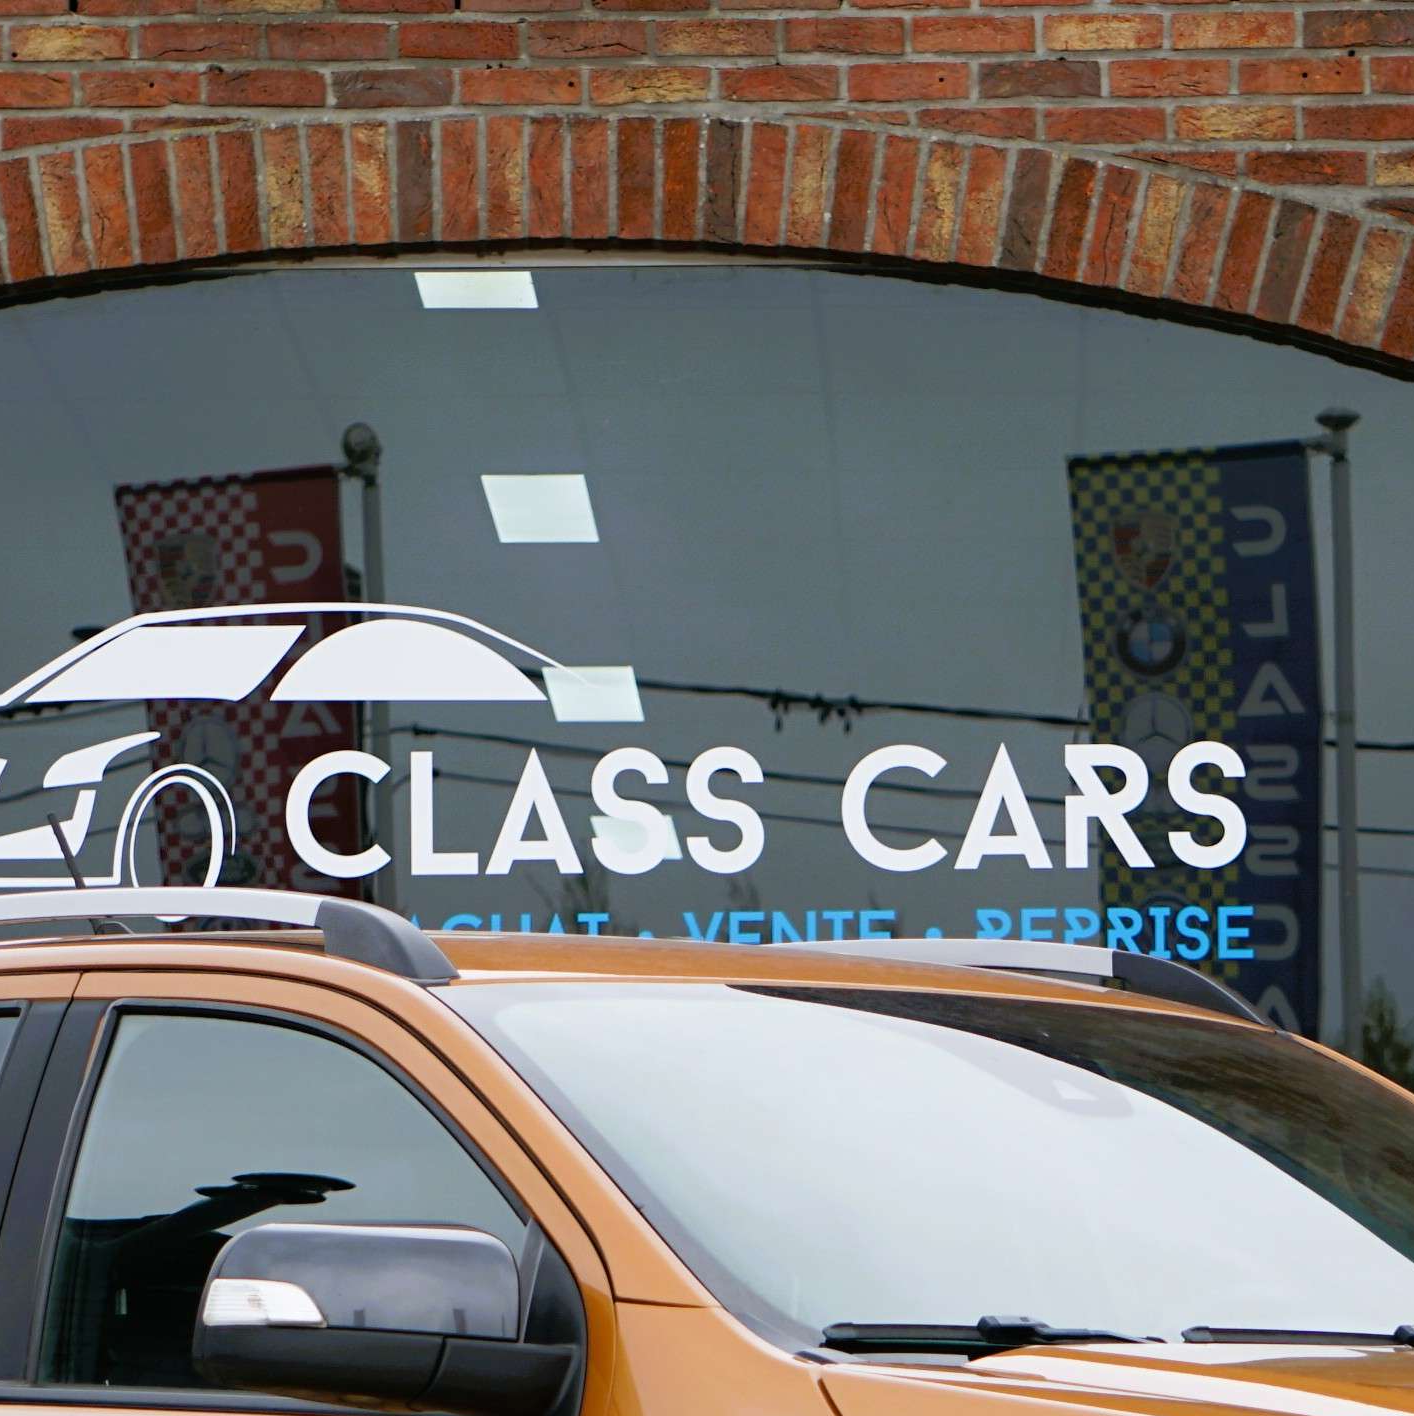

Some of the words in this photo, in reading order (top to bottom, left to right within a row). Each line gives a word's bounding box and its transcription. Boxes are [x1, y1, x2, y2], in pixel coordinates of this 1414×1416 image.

[285, 745, 764, 879] CLASS
[841, 741, 1247, 873] CARS
[975, 905, 1255, 961] REPRISE
